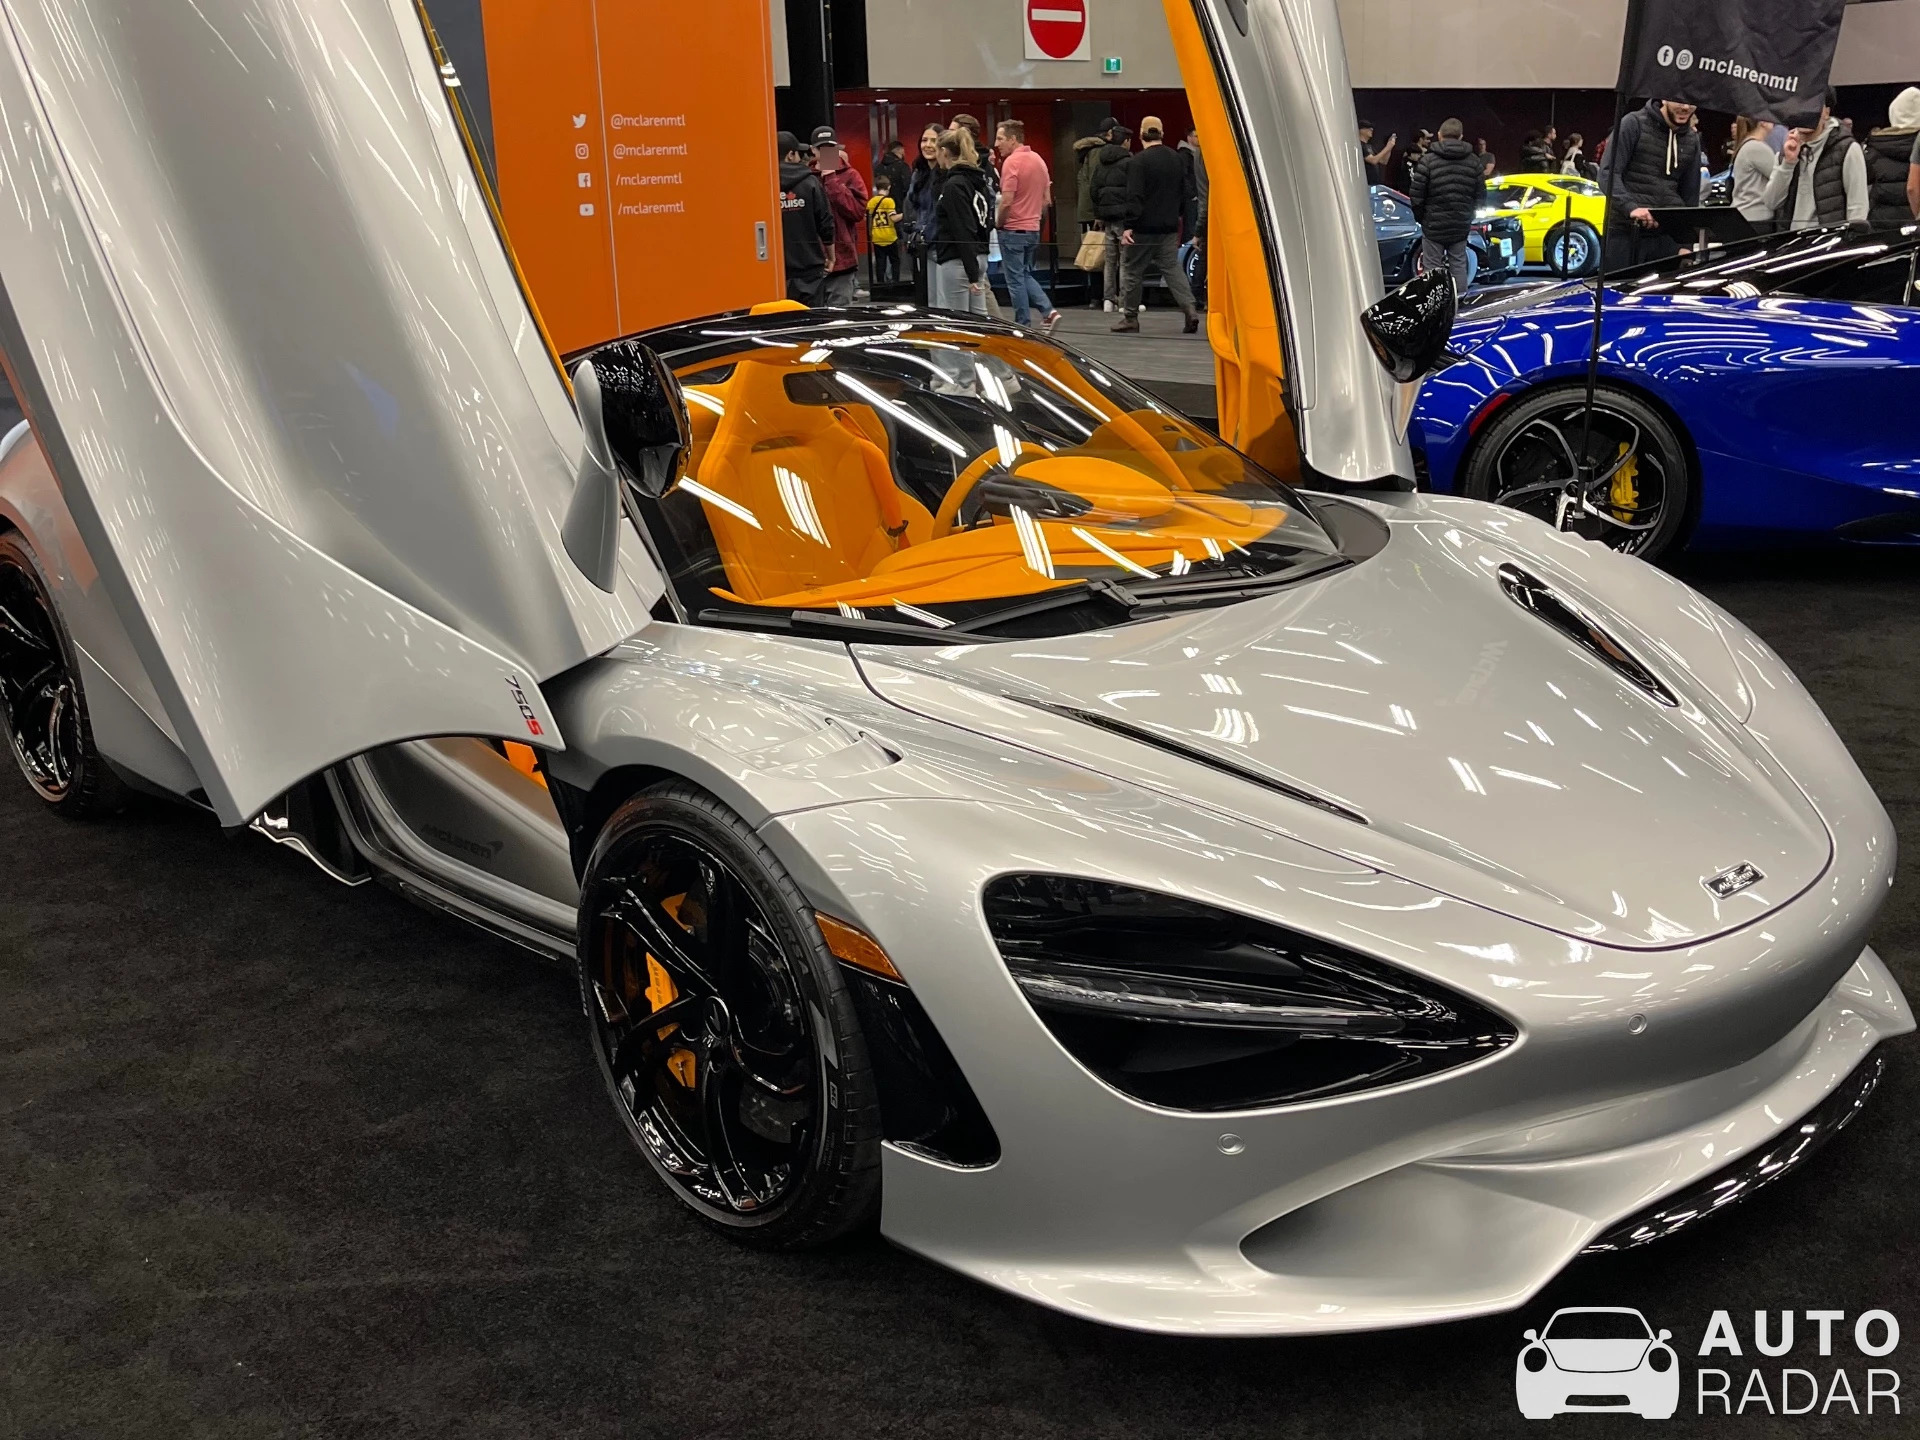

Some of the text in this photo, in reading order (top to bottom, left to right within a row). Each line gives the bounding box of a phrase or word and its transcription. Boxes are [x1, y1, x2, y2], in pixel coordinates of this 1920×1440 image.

[1699, 56, 1799, 93] mclarenmtl
[610, 113, 686, 130] @mclarenmtl
[613, 143, 688, 159] @mclarenmtl
[615, 172, 683, 186] /mclarenmtl
[618, 200, 685, 216] /mclarenmtl
[504, 675, 545, 736] 750S
